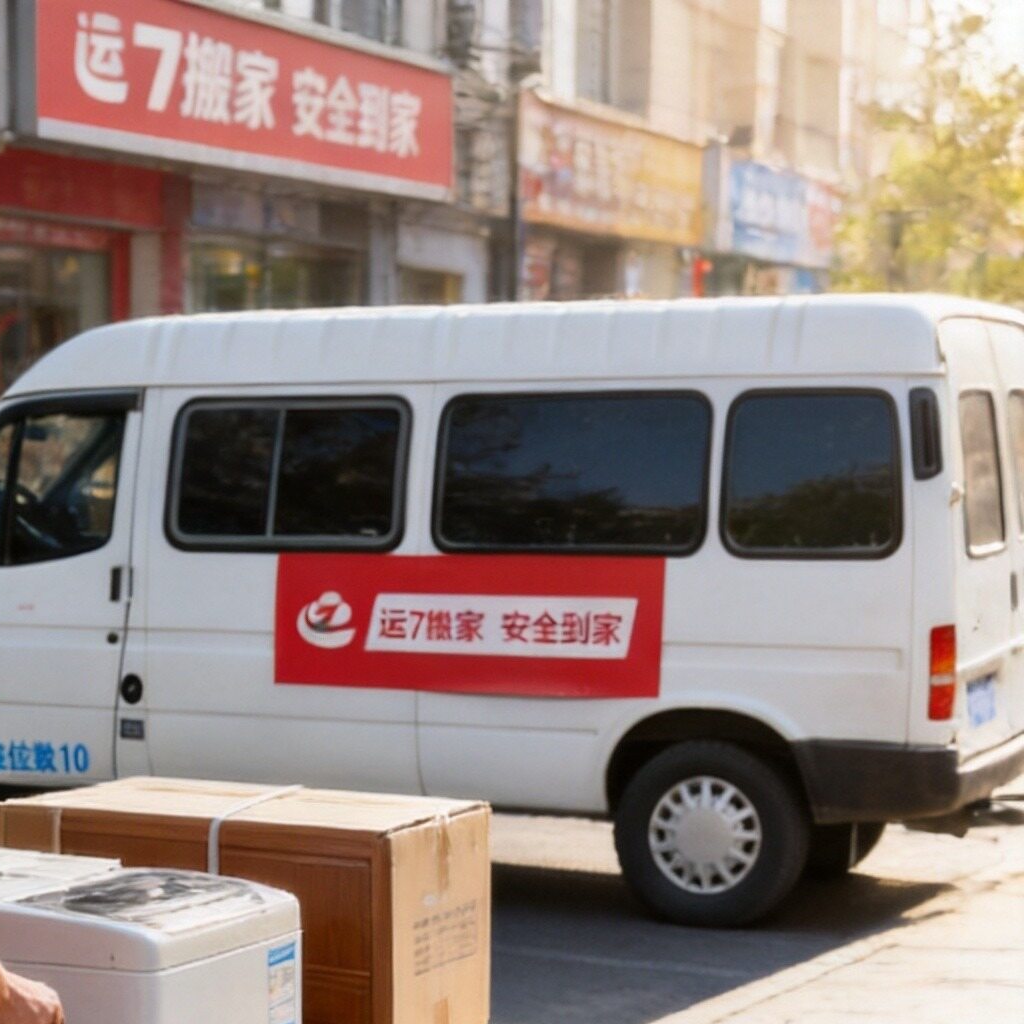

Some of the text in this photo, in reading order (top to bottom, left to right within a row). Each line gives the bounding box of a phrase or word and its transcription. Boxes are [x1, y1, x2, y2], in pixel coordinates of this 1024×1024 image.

[74, 12, 421, 157] 运7搬家 安全到家
[501, 610, 622, 645] 安全到家
